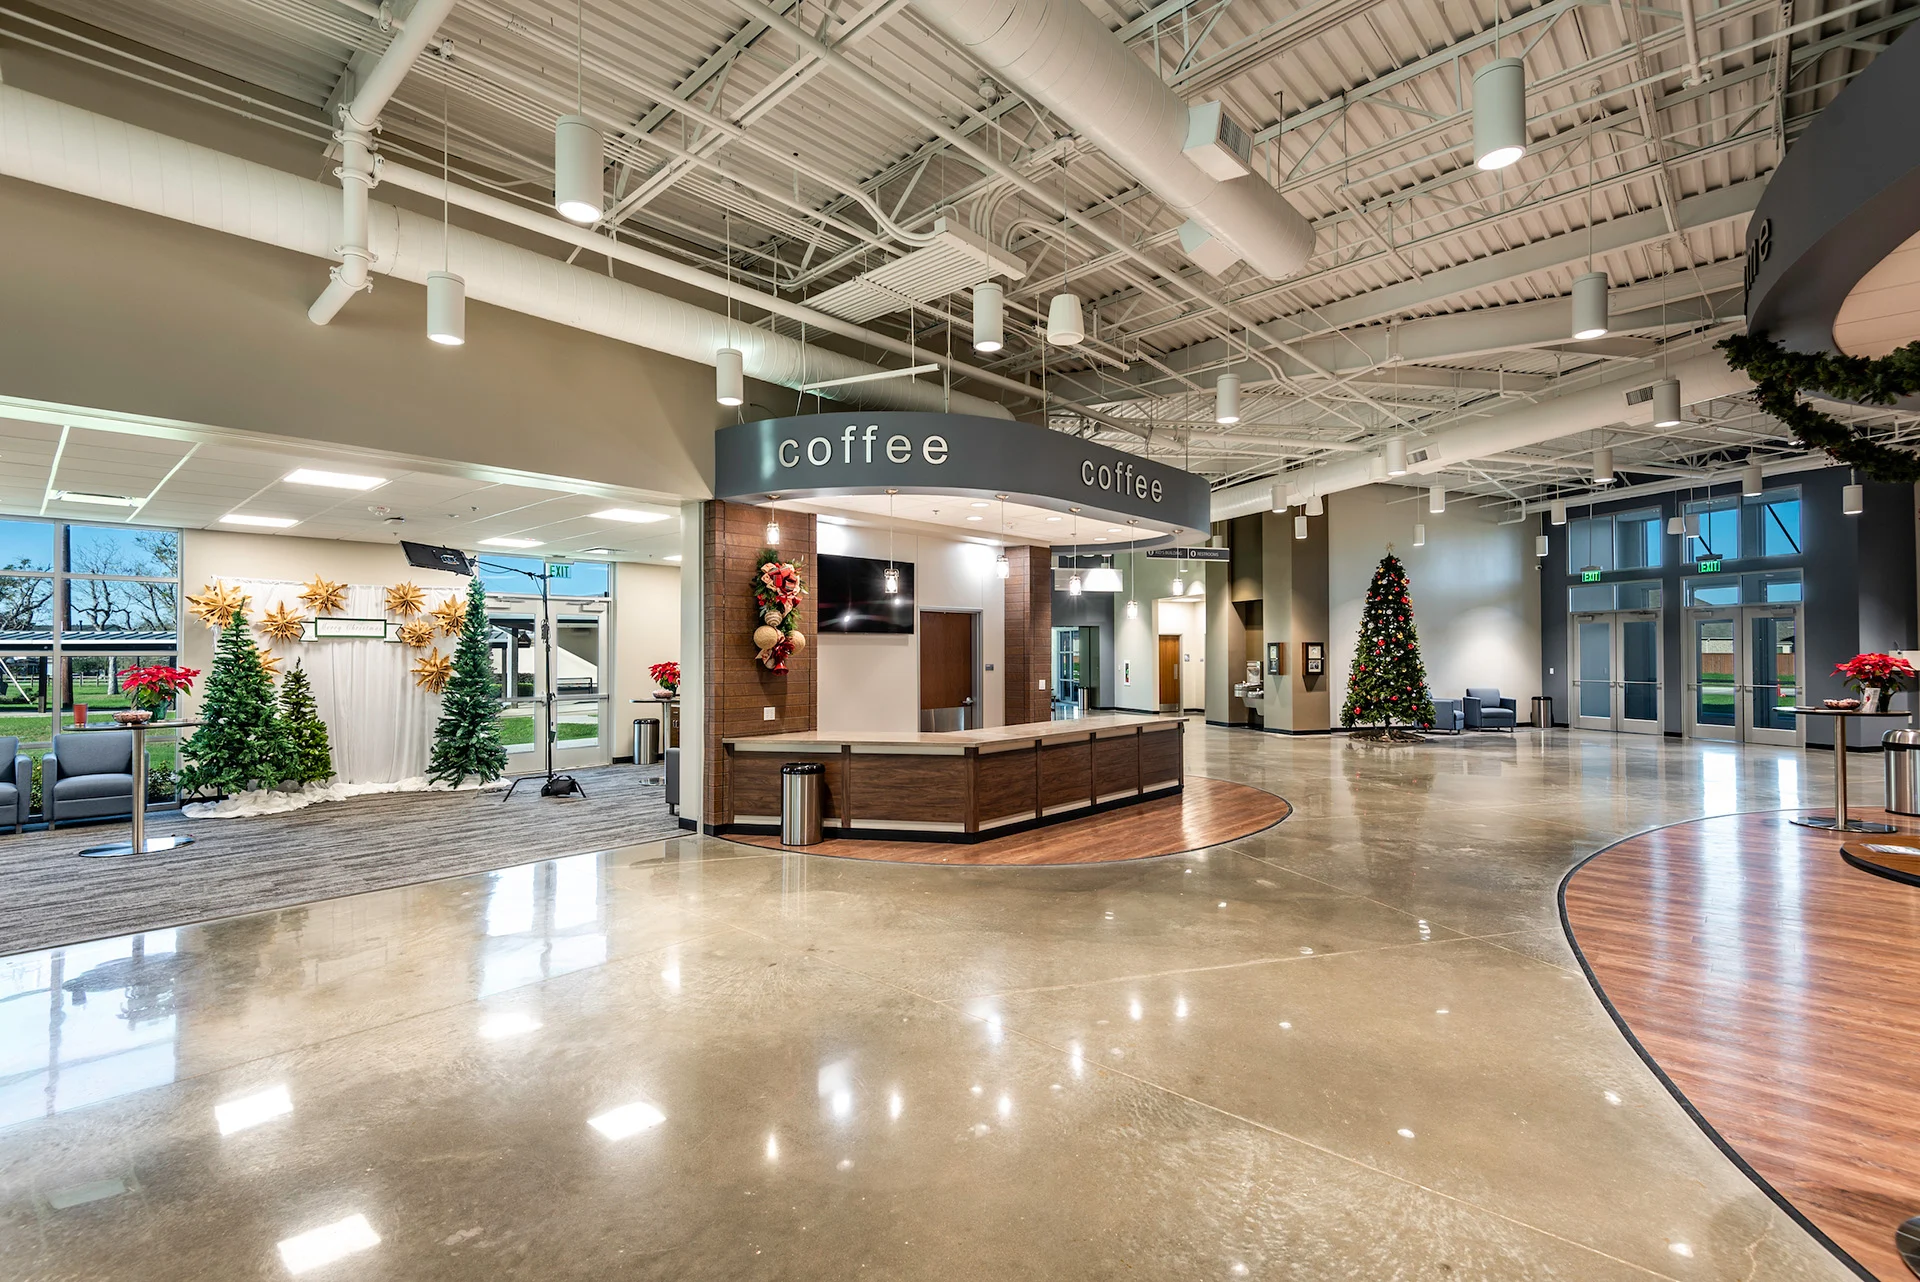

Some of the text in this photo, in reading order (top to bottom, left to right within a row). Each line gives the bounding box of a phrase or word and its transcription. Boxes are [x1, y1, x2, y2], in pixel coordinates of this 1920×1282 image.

[778, 424, 949, 469] coffee
[1081, 458, 1163, 503] coffee
[549, 565, 569, 578] EXIT
[1701, 561, 1717, 572] EXIT
[1585, 572, 1598, 581] EXIT
[321, 622, 382, 633] Merry Christmas
